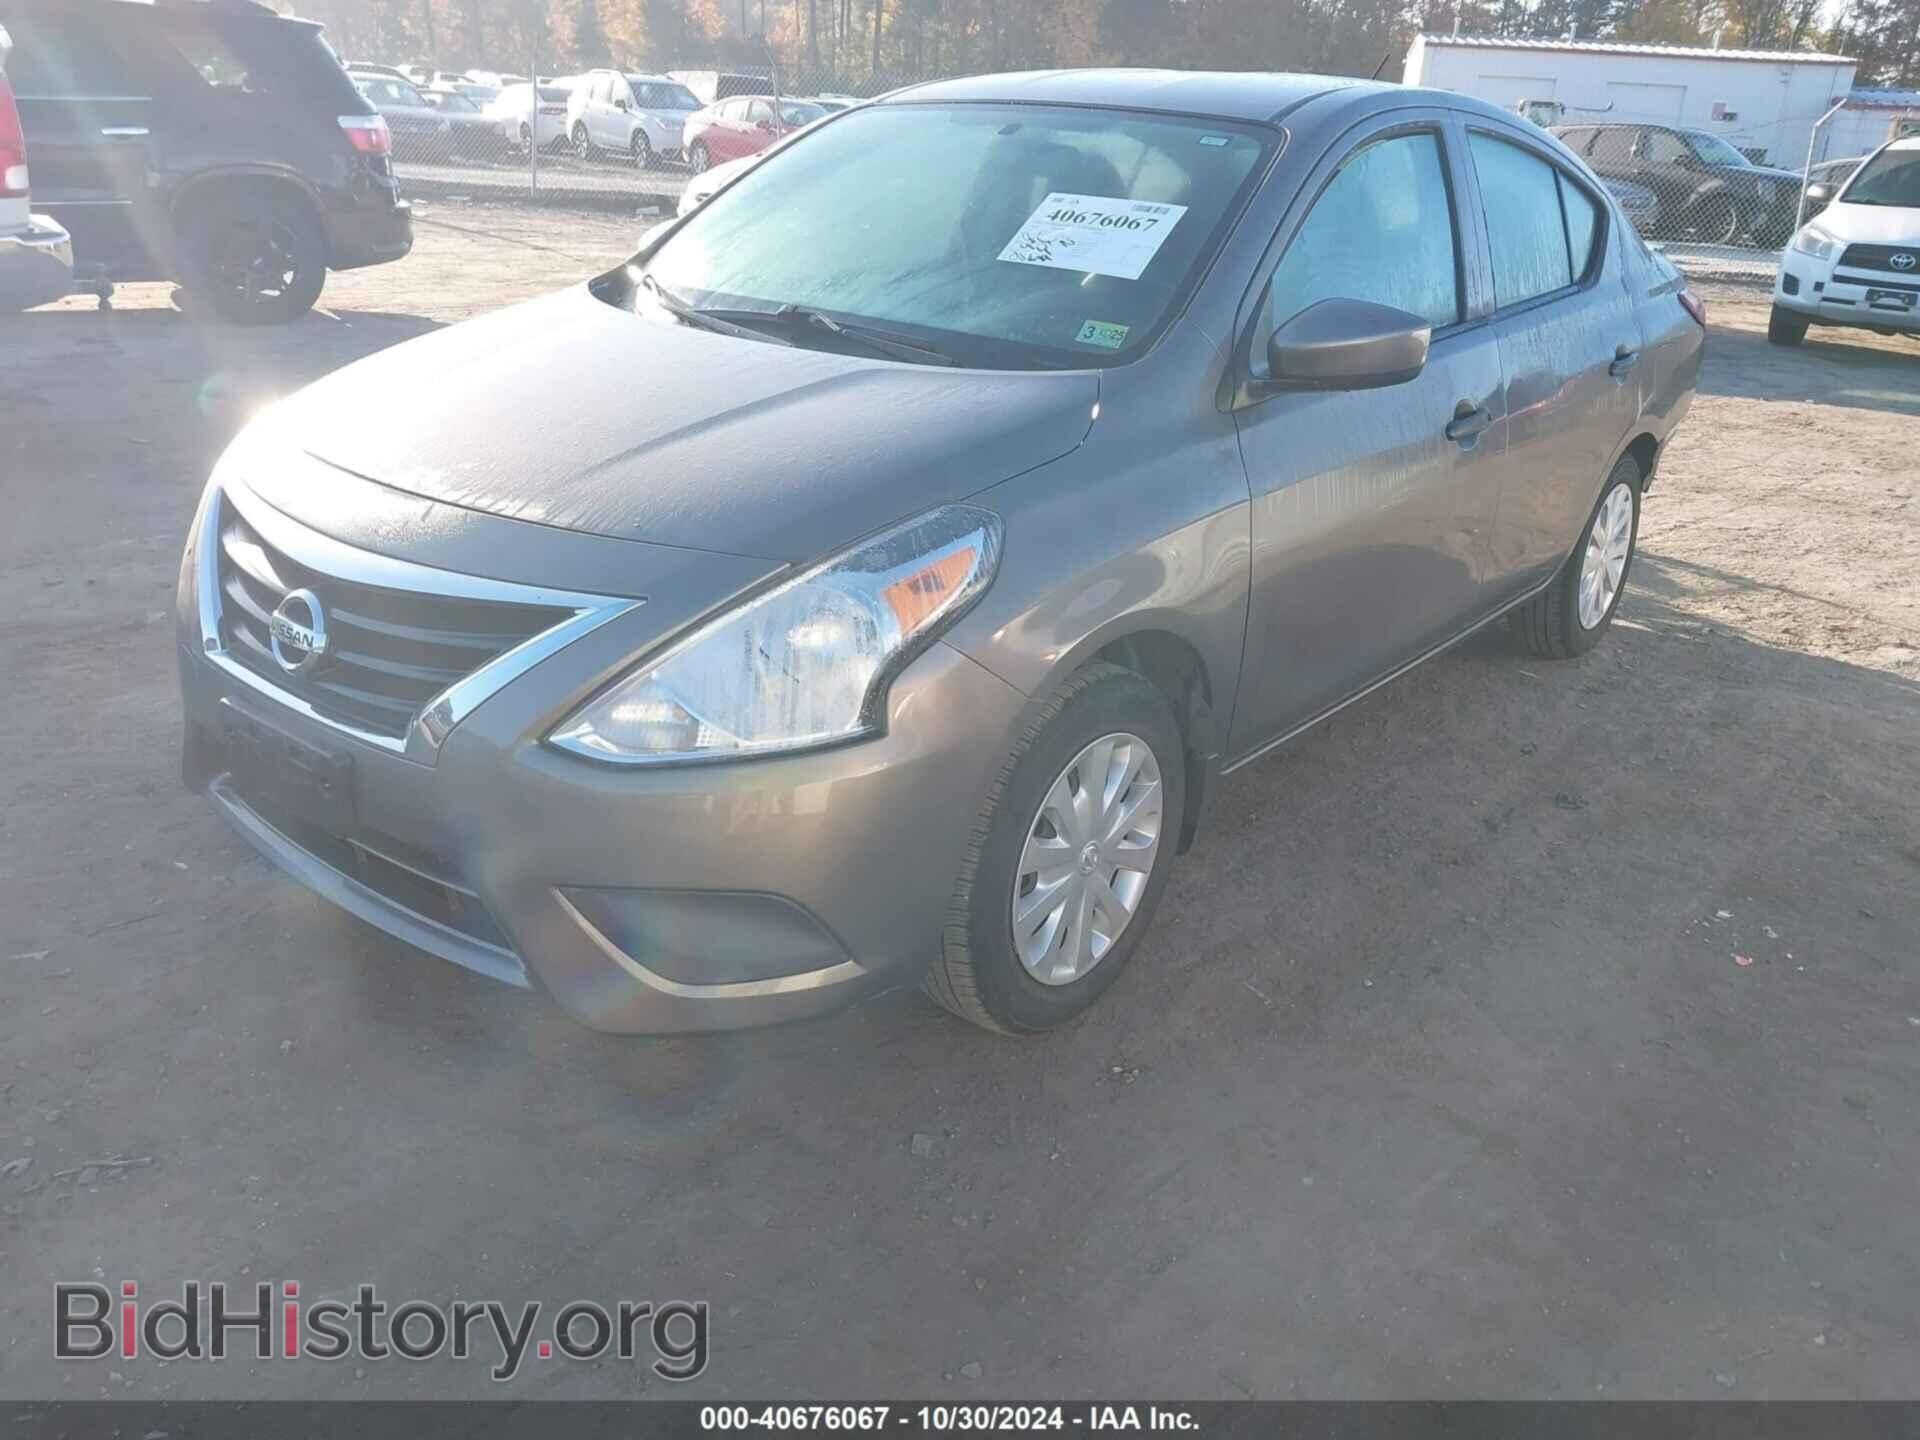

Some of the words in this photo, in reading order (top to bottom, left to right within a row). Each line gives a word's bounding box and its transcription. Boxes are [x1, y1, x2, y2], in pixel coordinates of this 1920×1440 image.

[1047, 208, 1160, 232] 40676067
[1083, 326, 1096, 339] 3
[271, 618, 314, 648] SSAN
